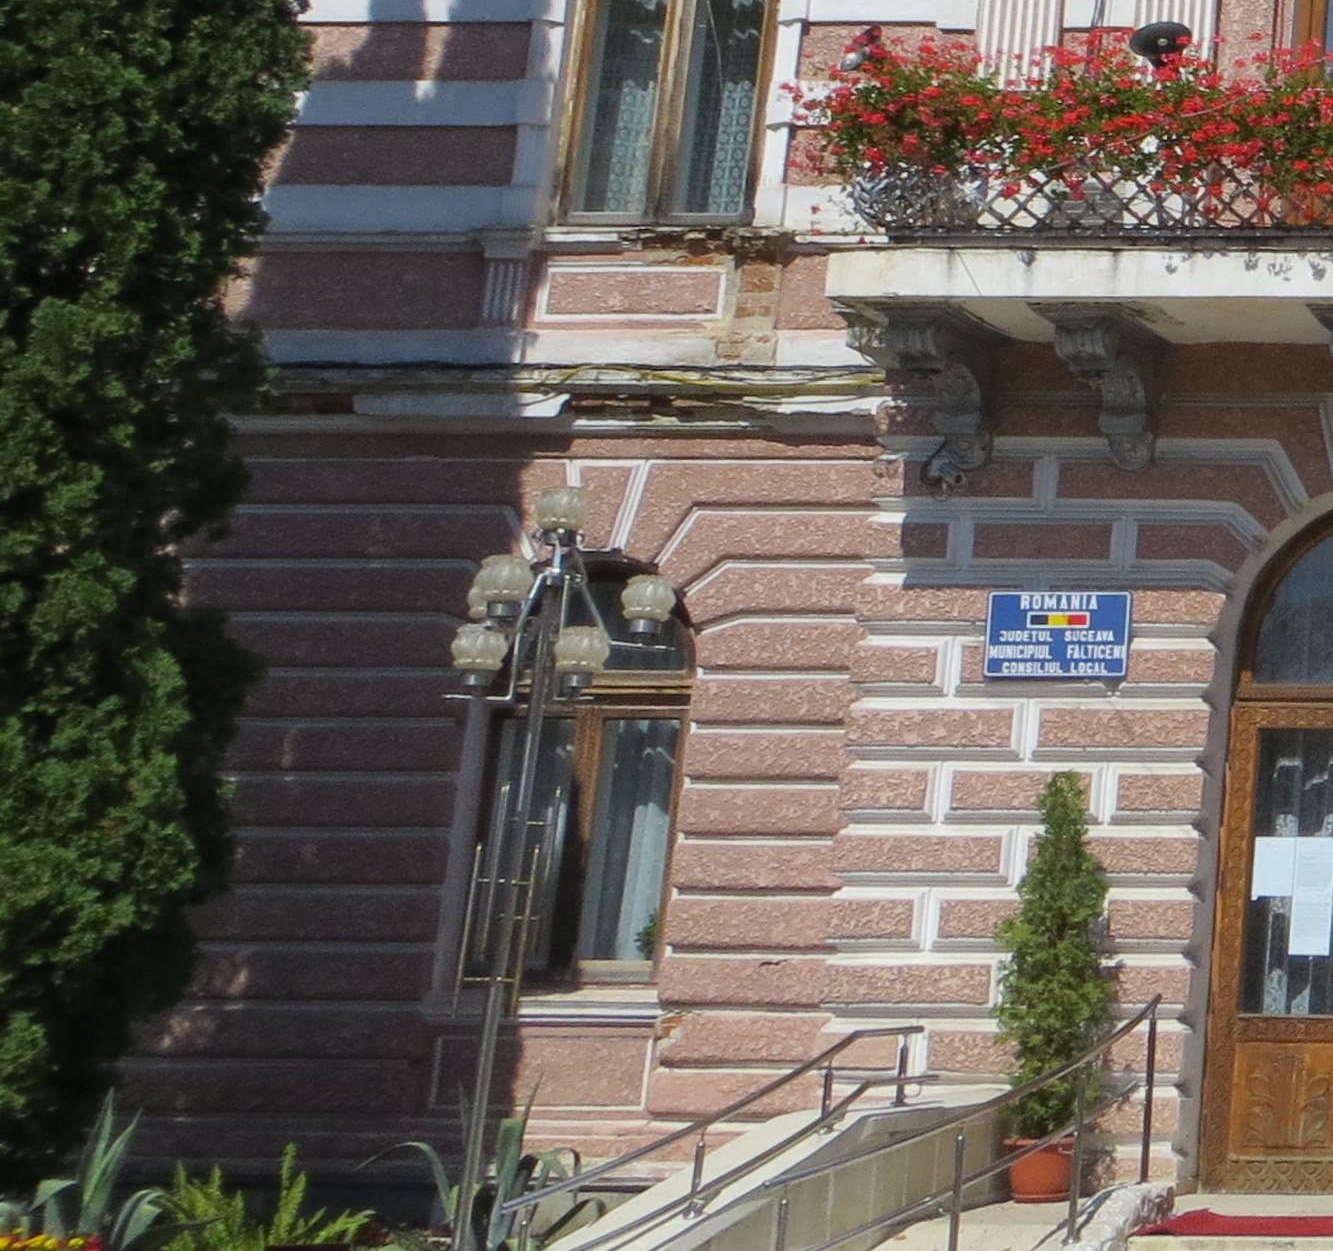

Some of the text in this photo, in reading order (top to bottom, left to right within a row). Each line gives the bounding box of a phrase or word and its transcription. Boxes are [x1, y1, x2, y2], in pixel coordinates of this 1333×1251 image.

[1020, 595, 1099, 610] ROMANIA
[1064, 630, 1115, 642] SUCEAVA
[989, 644, 1053, 660] MUNICIPIUL
[1002, 661, 1108, 674] CONSILIUL LOCAL
